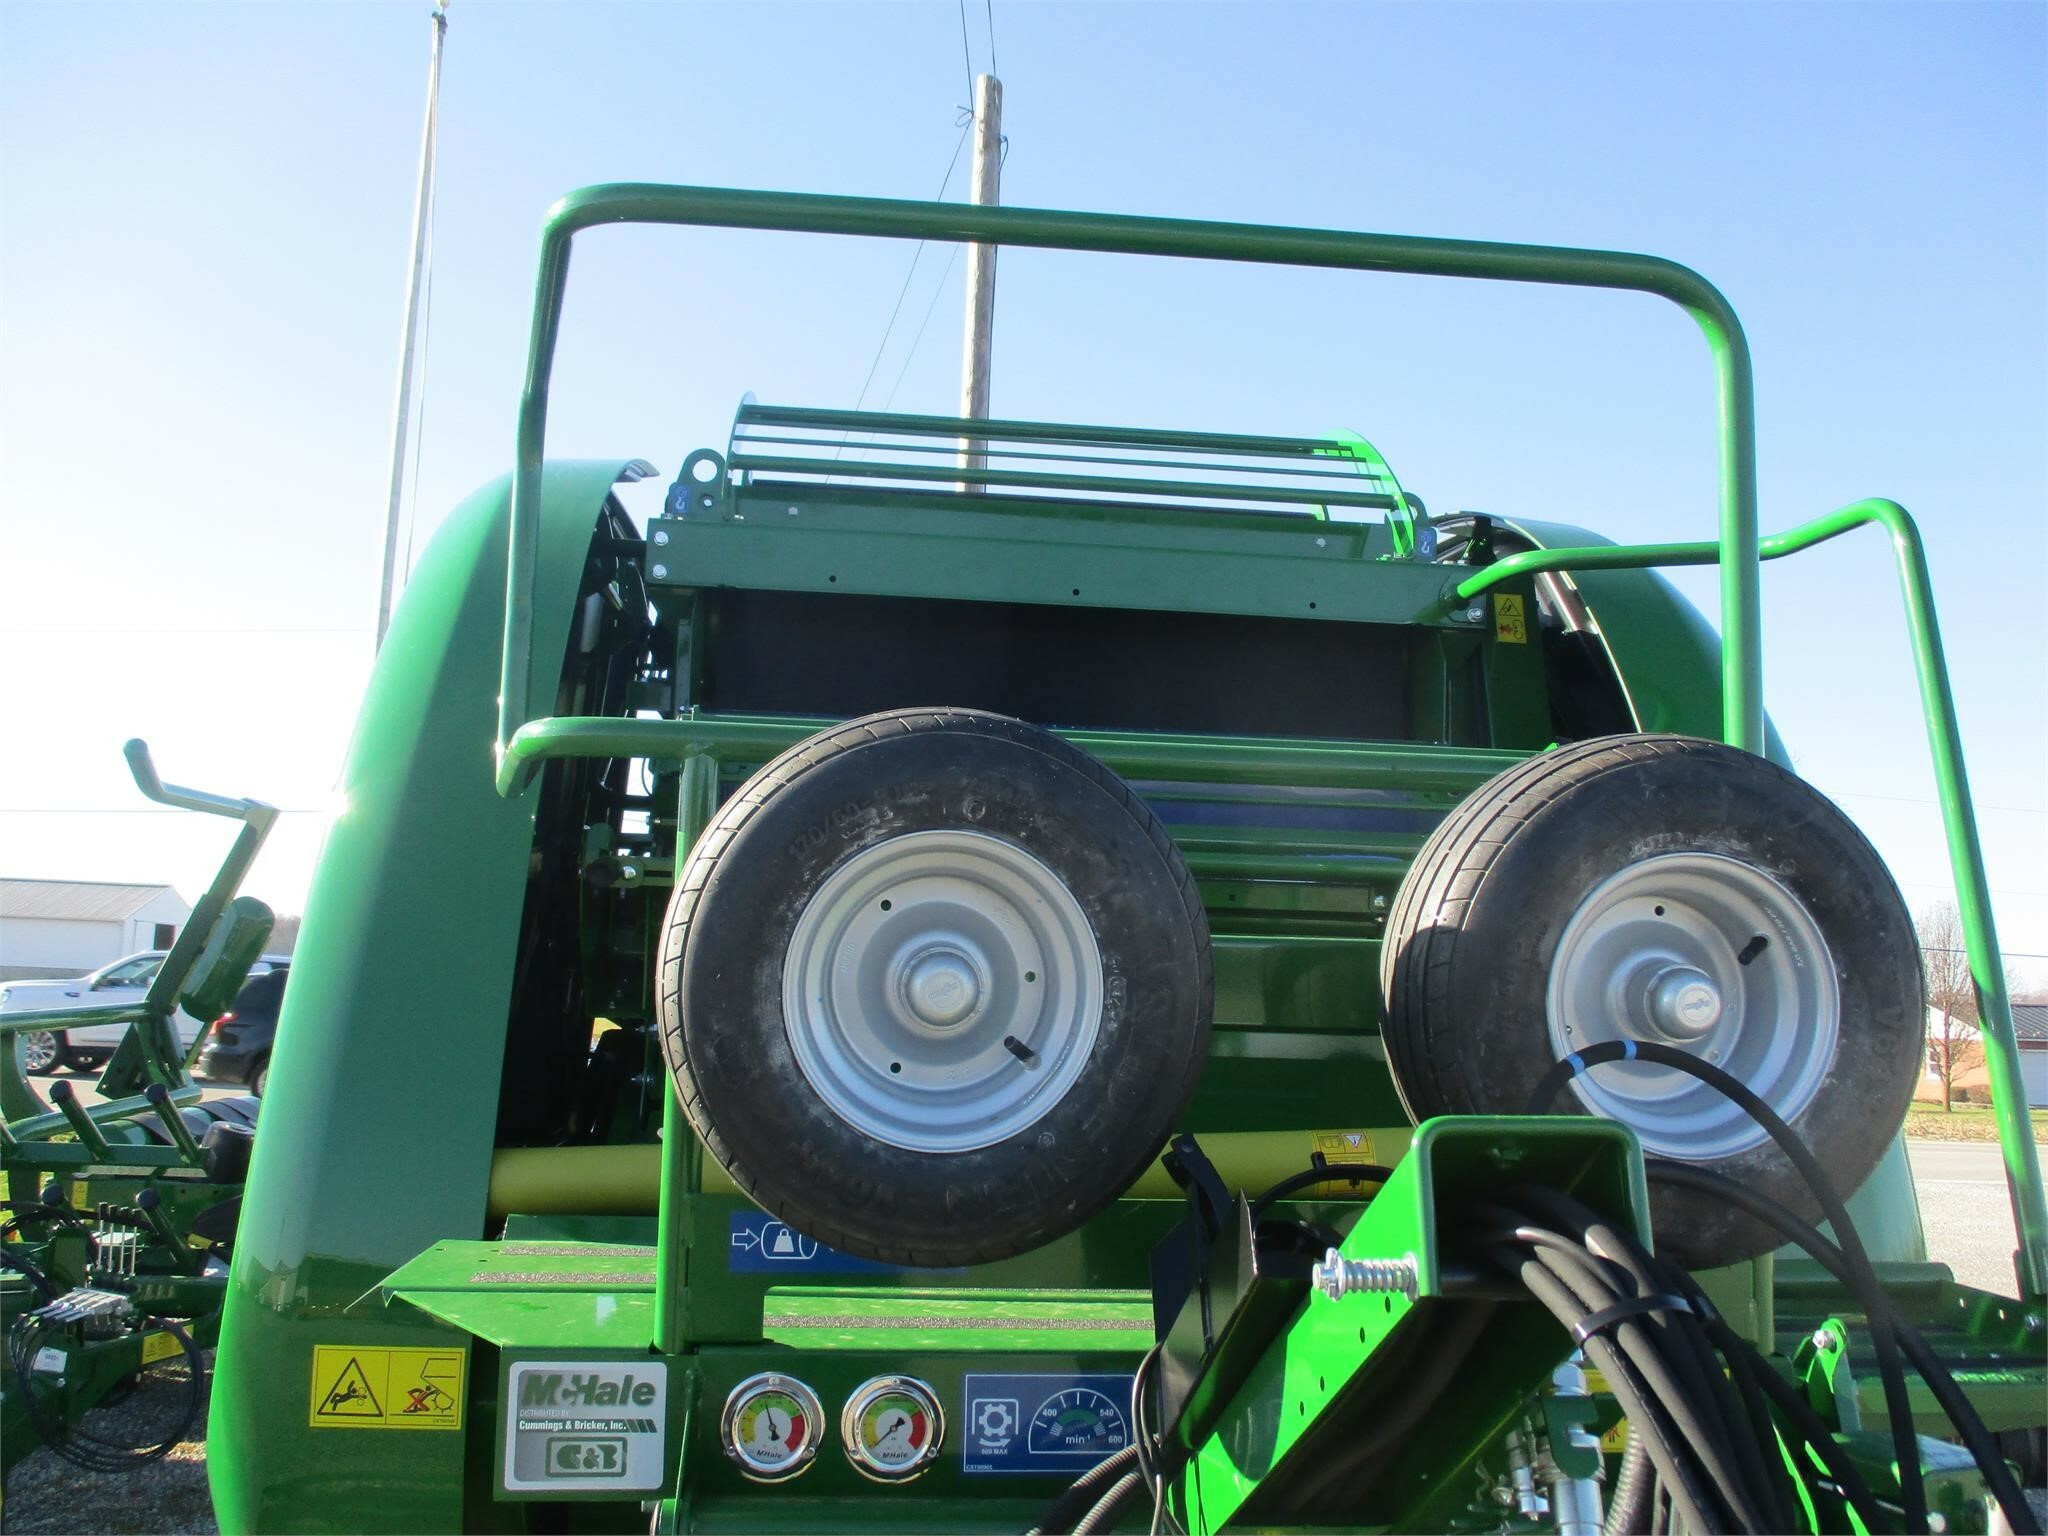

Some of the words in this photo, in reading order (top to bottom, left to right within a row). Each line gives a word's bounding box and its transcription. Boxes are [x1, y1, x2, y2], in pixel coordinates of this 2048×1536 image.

[521, 1374, 656, 1407] McHale
[519, 1409, 559, 1417] DISTRIBUTED
[1042, 1409, 1057, 1417] 400
[1100, 1409, 1114, 1417] 540
[519, 1420, 563, 1431] Cummings
[565, 1420, 573, 1430] &
[574, 1420, 608, 1431] Bricker,
[610, 1420, 627, 1430] Inc.
[1108, 1435, 1123, 1444] 600
